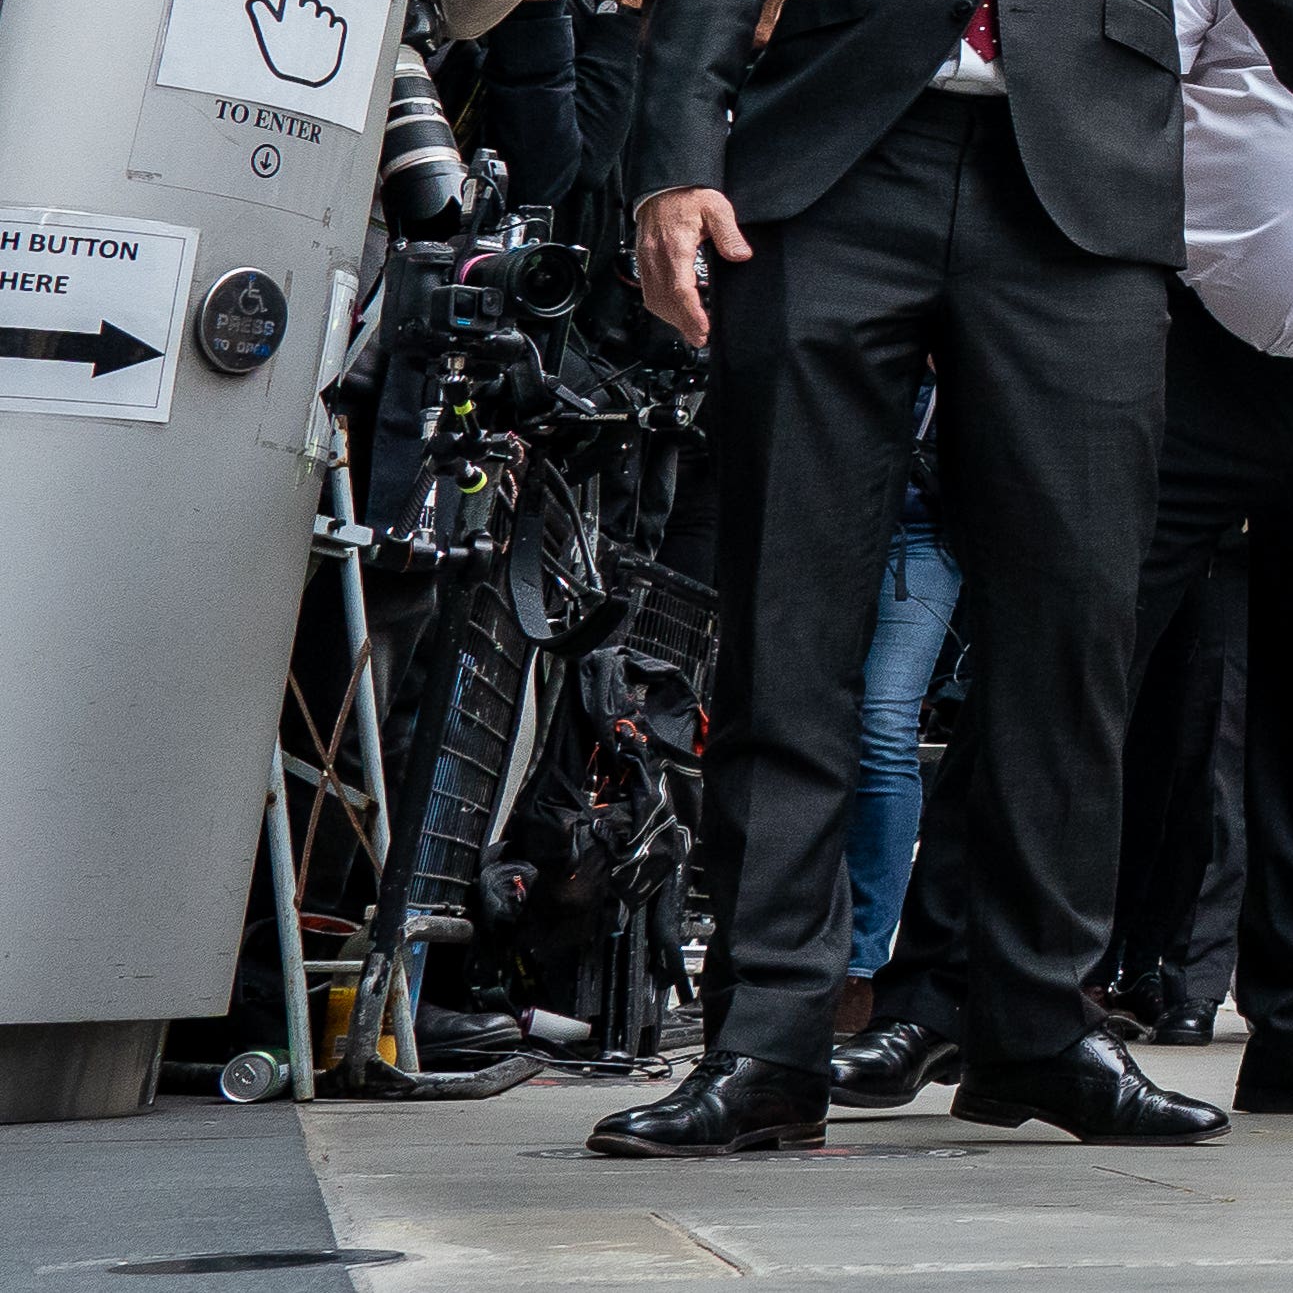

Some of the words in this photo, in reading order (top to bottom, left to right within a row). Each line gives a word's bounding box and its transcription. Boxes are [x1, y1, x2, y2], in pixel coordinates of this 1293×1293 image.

[215, 99, 249, 124] TO
[254, 108, 322, 144] ENTER
[28, 233, 139, 261] BUTTON
[0, 271, 70, 294] HERE
[217, 313, 275, 336] PRESS
[213, 338, 230, 351] TO
